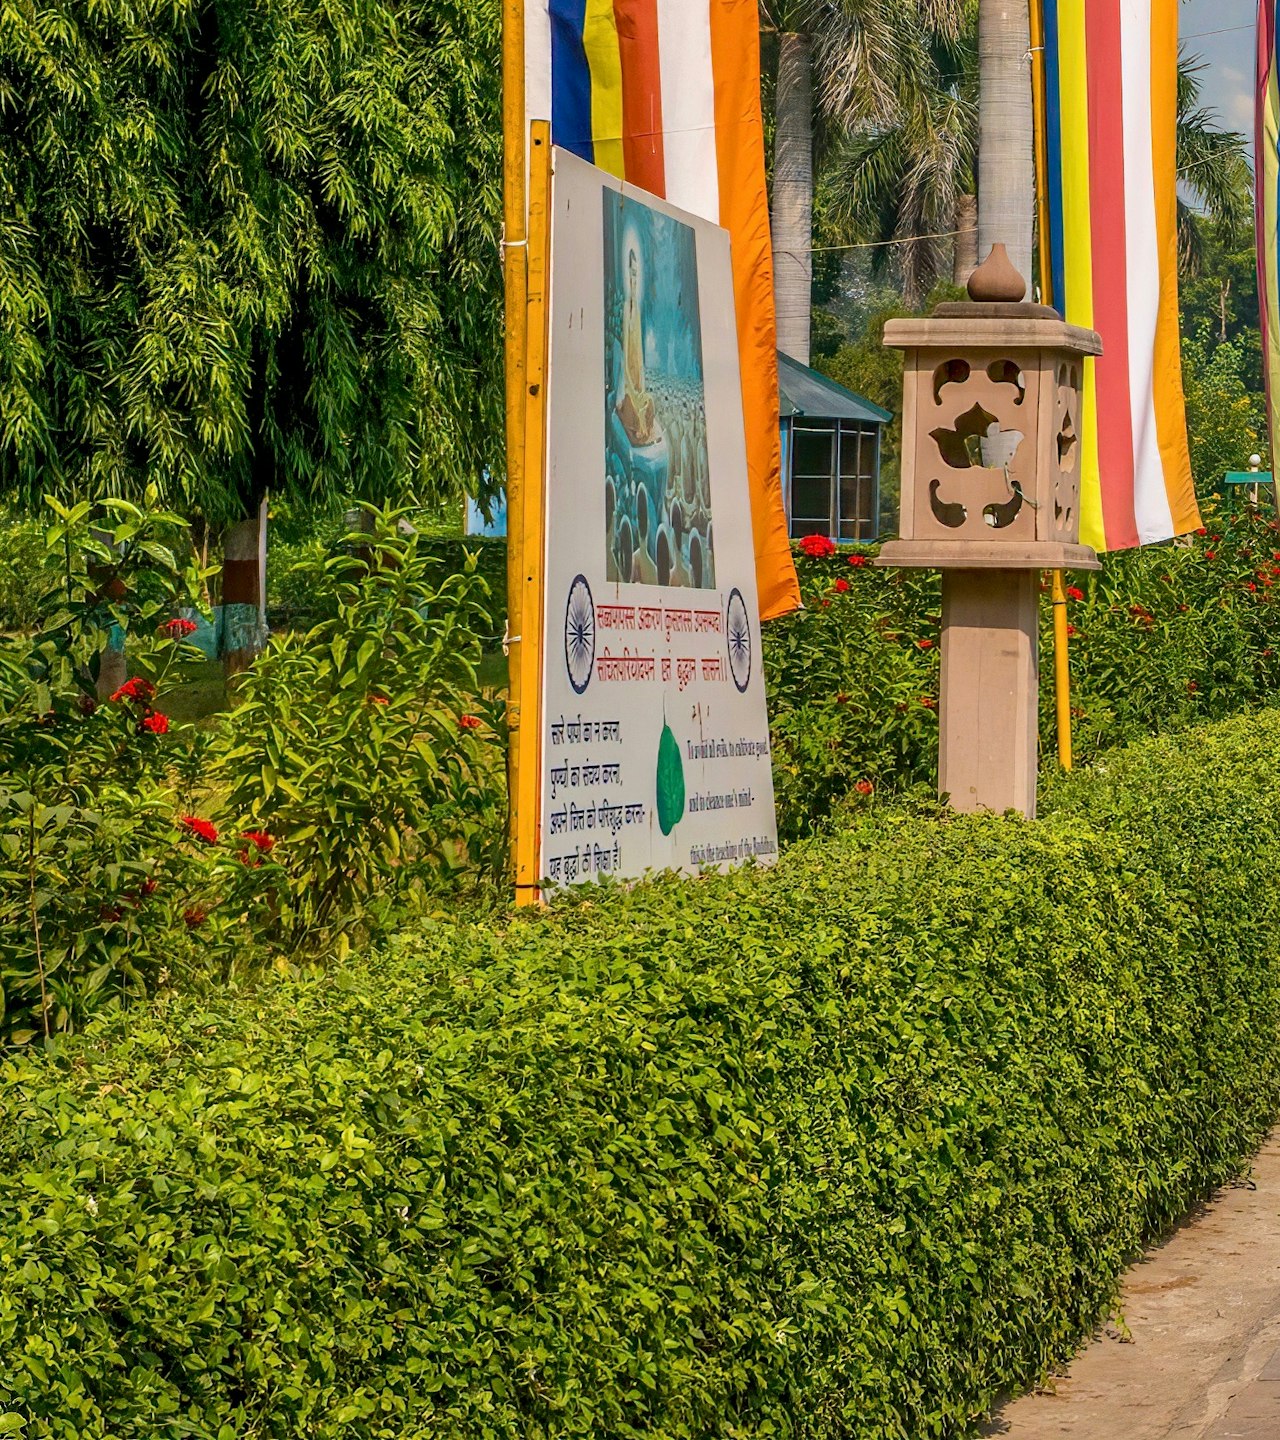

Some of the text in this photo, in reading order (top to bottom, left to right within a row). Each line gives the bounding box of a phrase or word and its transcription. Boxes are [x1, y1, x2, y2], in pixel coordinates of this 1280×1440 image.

[551, 715, 565, 745] सारे
[583, 722, 592, 743] का
[594, 722, 600, 743] न
[571, 766, 580, 787] का
[582, 758, 600, 786] संचय
[551, 803, 567, 835] अपने
[587, 800, 596, 829] को
[549, 857, 561, 880] यह
